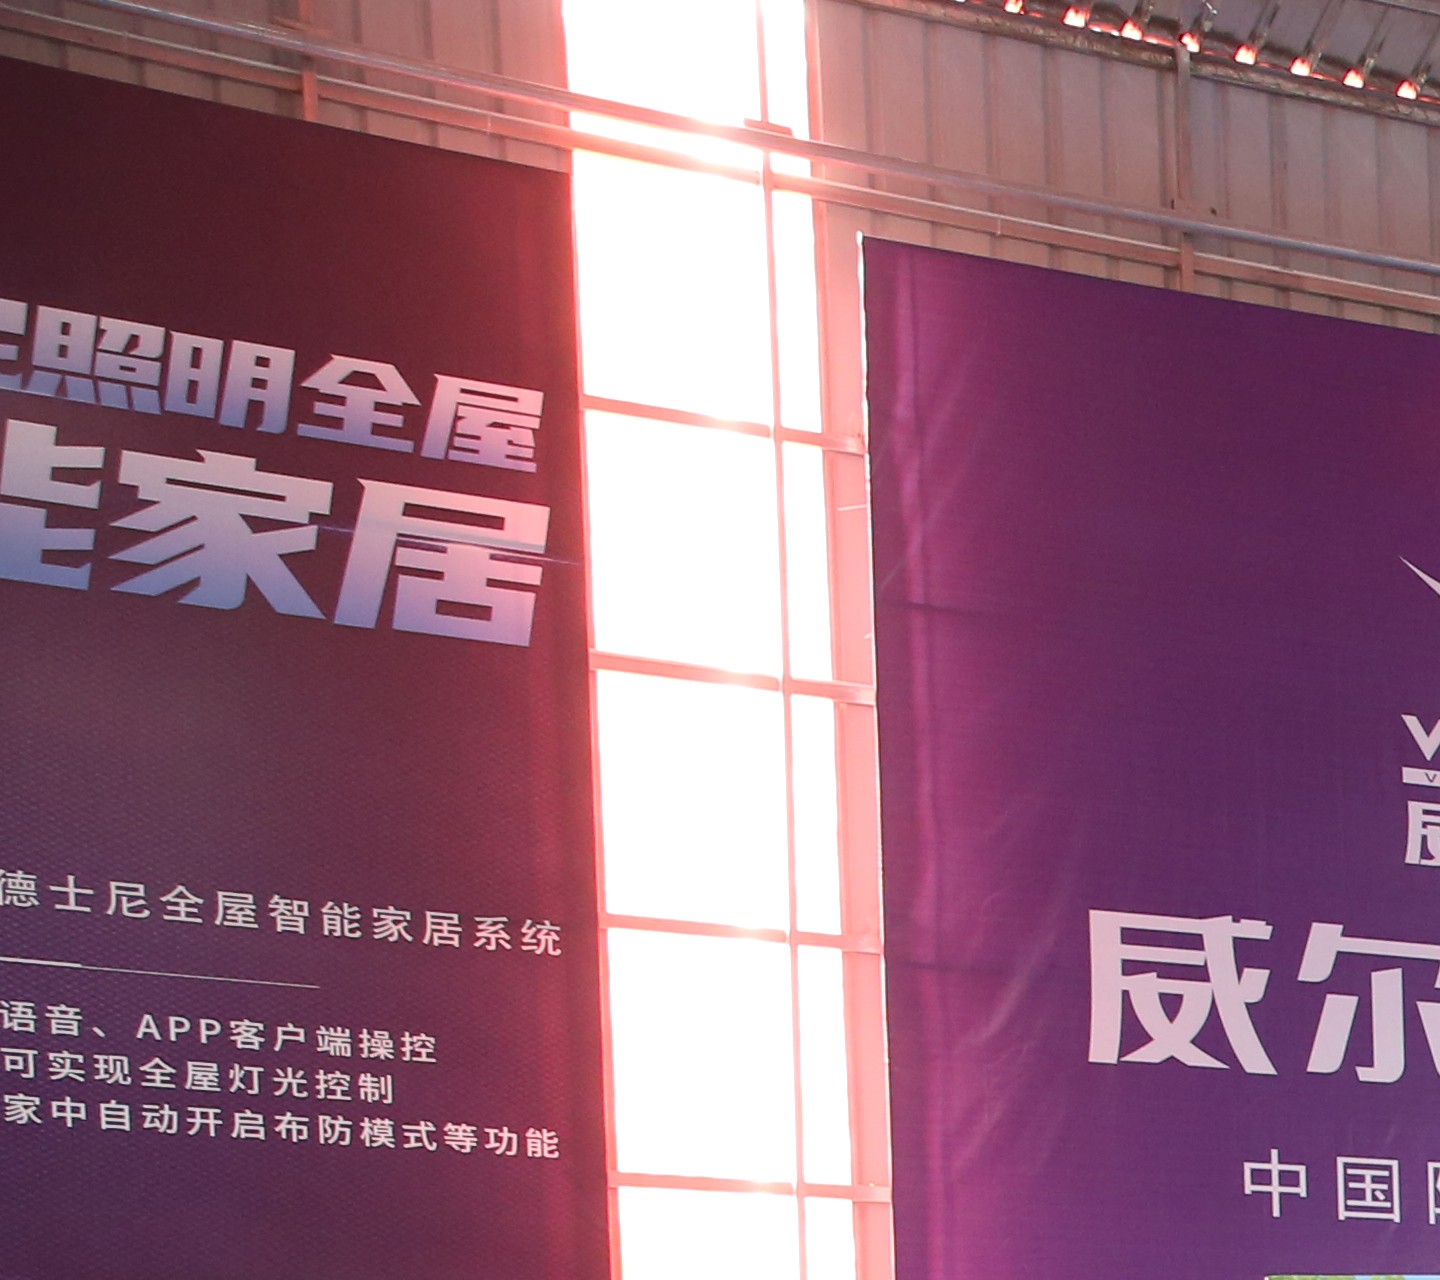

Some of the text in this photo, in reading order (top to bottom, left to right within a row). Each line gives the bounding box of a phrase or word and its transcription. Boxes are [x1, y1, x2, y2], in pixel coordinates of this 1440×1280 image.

[0, 868, 563, 957] 德士尼全屋智能家居系统
[0, 1002, 438, 1064] 语音、APP客户端操控
[3, 1046, 395, 1106] 可实现全屋灯光控制
[3, 1092, 561, 1160] 家中自动开启布防模式等功能
